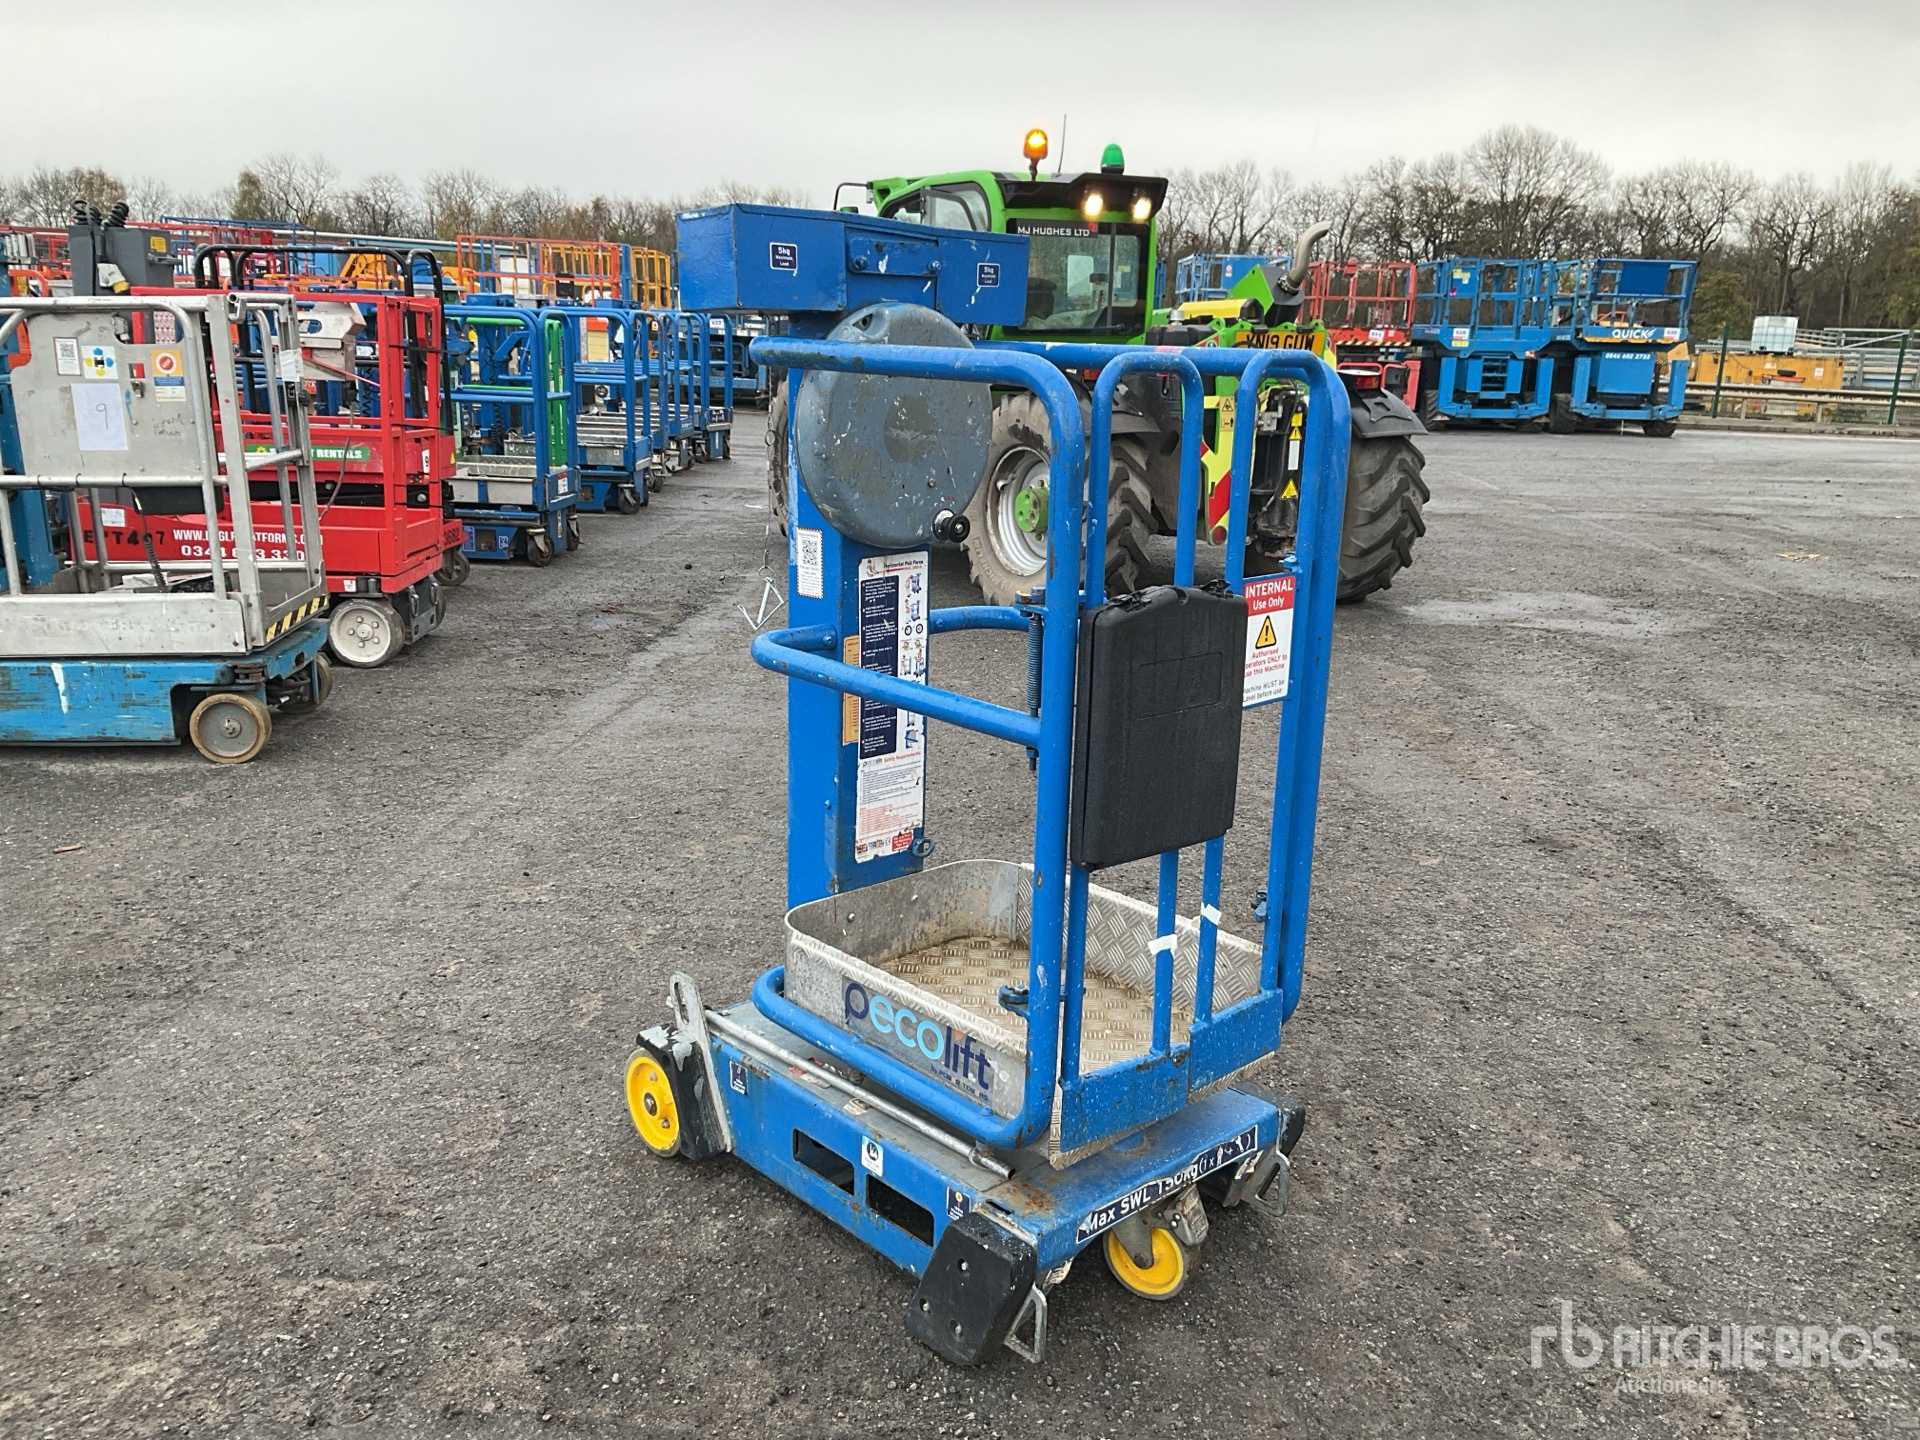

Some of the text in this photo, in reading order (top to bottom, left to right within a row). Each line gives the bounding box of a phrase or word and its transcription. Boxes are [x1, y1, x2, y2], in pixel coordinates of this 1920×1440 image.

[1017, 226, 1090, 237] MJ HUGHES LTD
[777, 246, 791, 256] 5kg
[1611, 328, 1649, 339] QUICK
[1245, 578, 1294, 599] INTERNAL
[1252, 596, 1285, 611] Use Only
[1251, 647, 1279, 659] Authorised
[1244, 659, 1267, 670] perators
[1267, 654, 1281, 664] ONLY
[1253, 668, 1264, 676] this
[1264, 663, 1285, 672] Machine
[1244, 678, 1285, 694] achine MUST be
[1256, 689, 1273, 699] before
[1272, 687, 1283, 695] use
[845, 982, 991, 1091] pecolift
[1087, 1205, 1116, 1234] Max
[1120, 1186, 1152, 1215] SWL
